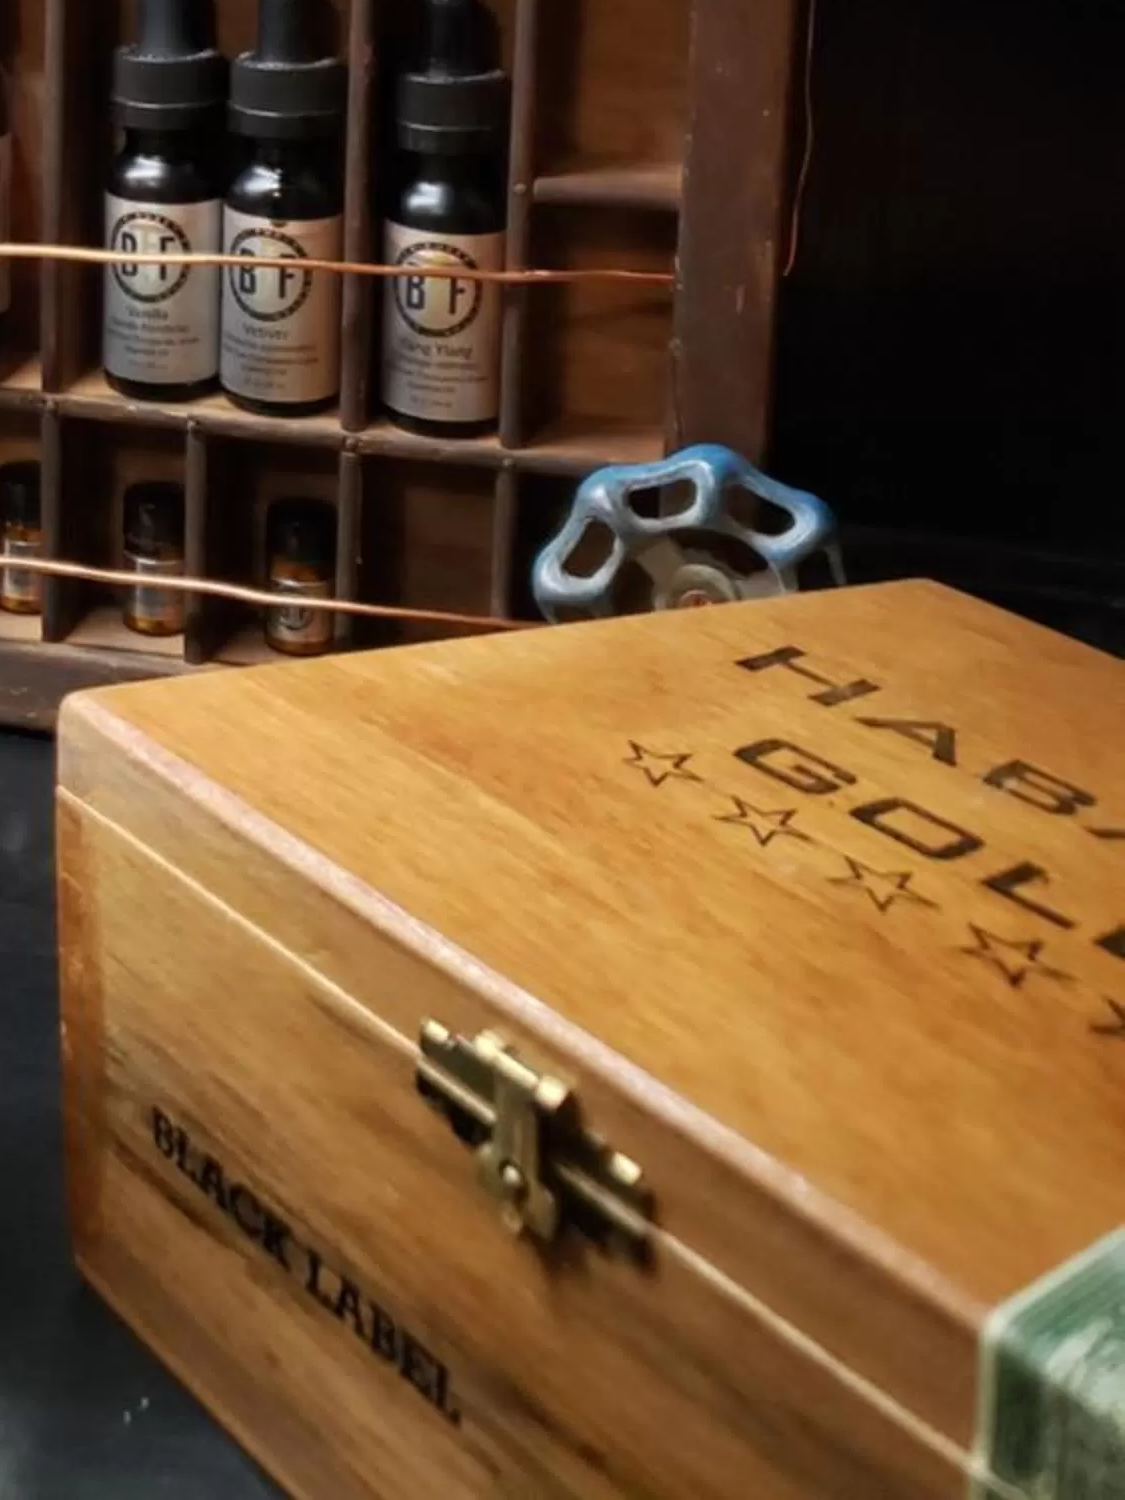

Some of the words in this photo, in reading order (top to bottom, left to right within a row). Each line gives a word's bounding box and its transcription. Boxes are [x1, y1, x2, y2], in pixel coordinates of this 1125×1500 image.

[733, 737, 1125, 960] GOL
[734, 644, 1125, 841] HAB
[150, 1105, 294, 1271] BLACK
[304, 1249, 462, 1425] LABEL
